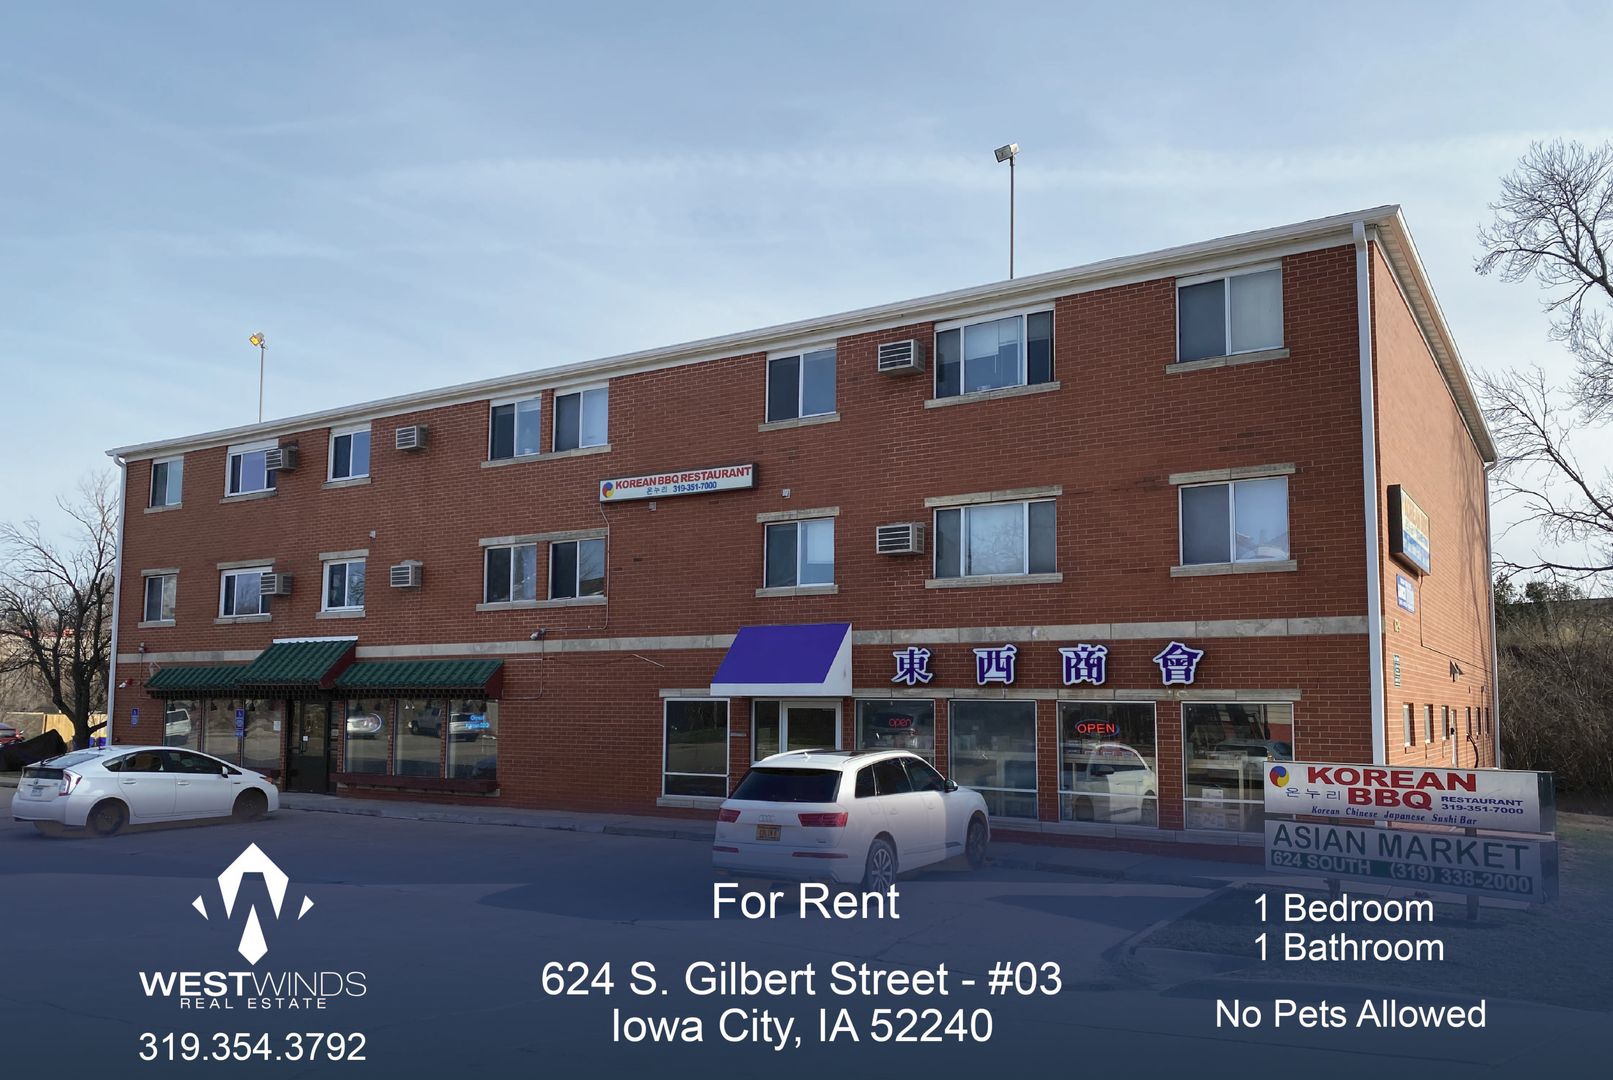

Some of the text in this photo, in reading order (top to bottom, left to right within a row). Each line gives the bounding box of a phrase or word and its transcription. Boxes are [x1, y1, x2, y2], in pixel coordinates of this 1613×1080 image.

[615, 466, 752, 490] KOREAN BBQ RESTAURANT
[673, 481, 717, 493] 319-351-7000
[891, 641, 1204, 686] 東西商會
[1077, 722, 1115, 734] OPEN
[1307, 766, 1477, 792] KOREAN
[1285, 787, 1341, 799] 온누리
[1348, 787, 1432, 811] BBQ
[1441, 796, 1523, 807] RESTAURANT
[1311, 806, 1477, 826] Korean Chinese Japanese Sushi Bar
[1441, 803, 1524, 815] 319-351-7000
[1273, 823, 1529, 871] ASIAN MARKET
[1272, 852, 1530, 893] 624 SOUTH (319) 338-2000
